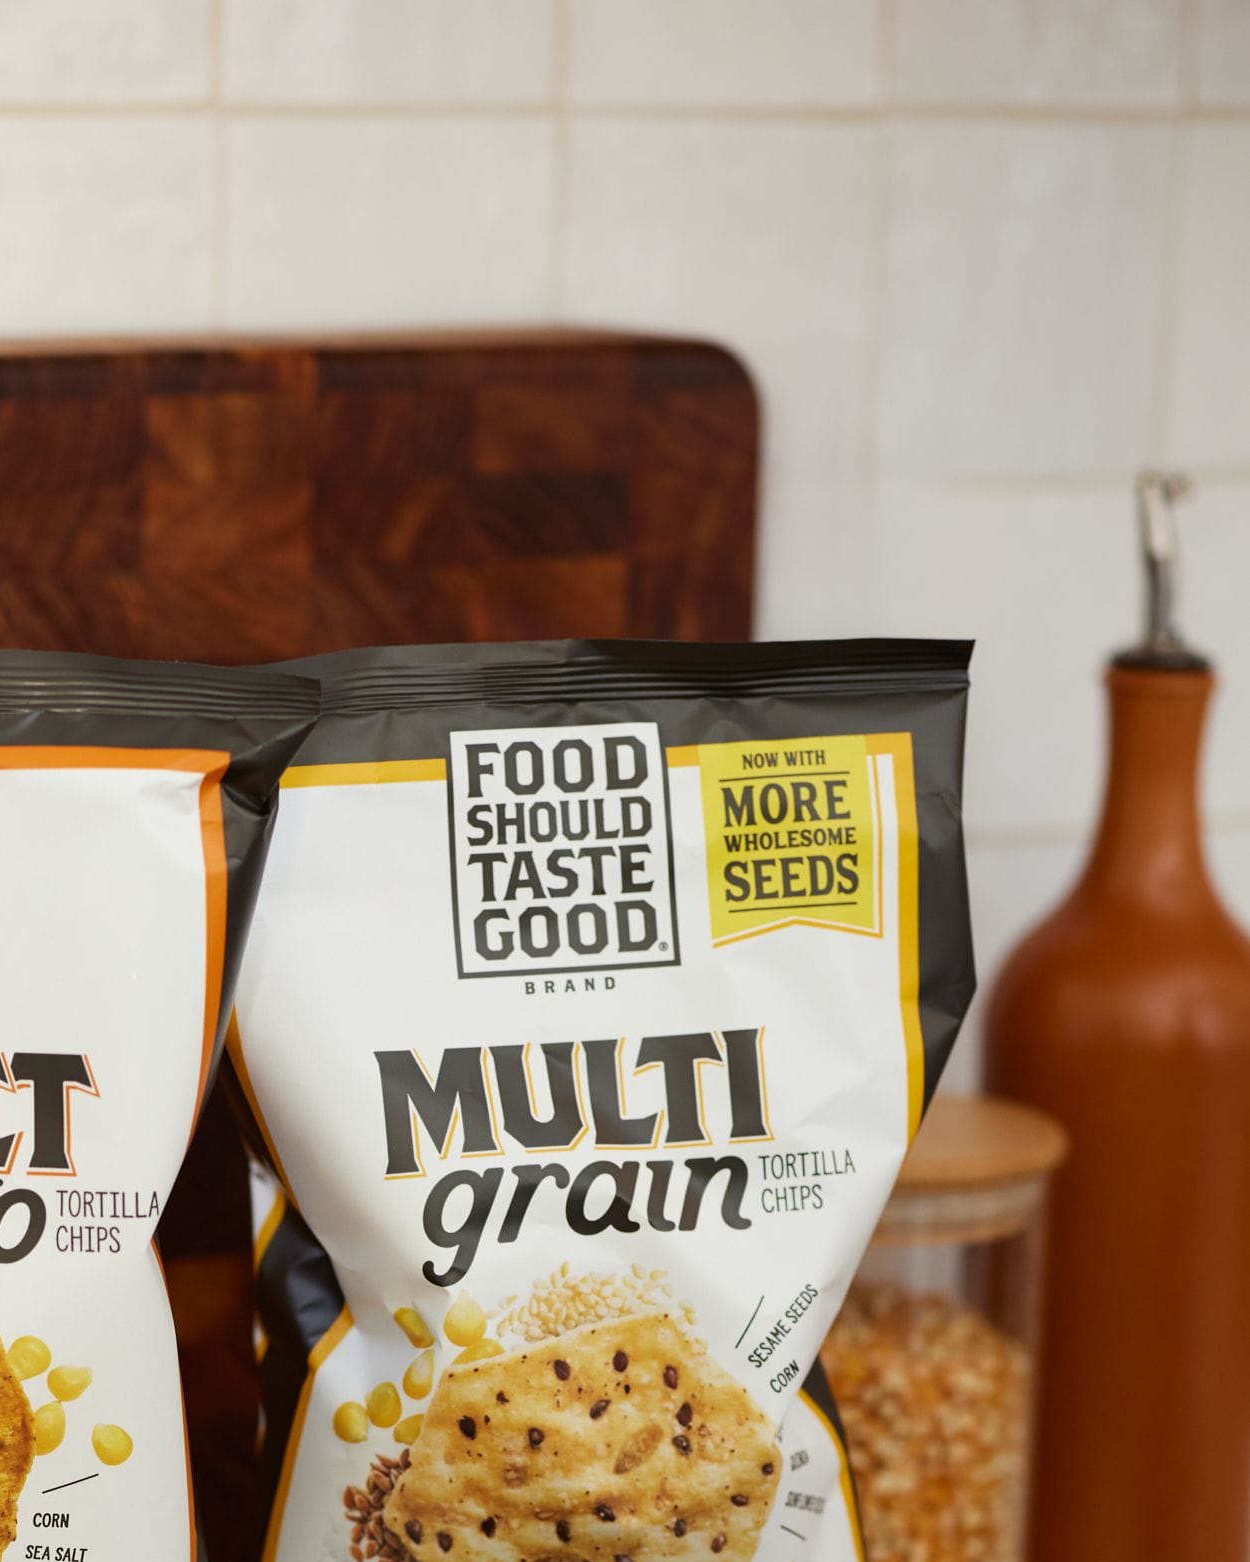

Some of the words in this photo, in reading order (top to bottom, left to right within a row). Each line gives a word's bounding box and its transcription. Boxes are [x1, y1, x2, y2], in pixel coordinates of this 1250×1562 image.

[464, 735, 648, 799] FOOD
[741, 751, 779, 771] NOW
[786, 749, 826, 767] WITH
[722, 780, 852, 828] MORE
[466, 795, 653, 848] SHOULD
[724, 828, 857, 852] WHOLESOME
[467, 844, 655, 902] TASTE
[724, 854, 860, 902] SEEDS
[525, 976, 617, 996] BRAND
[374, 1026, 774, 1180] MULTI
[757, 1149, 856, 1181] TORTILLA
[54, 1189, 161, 1219] TORTILLA
[760, 1183, 824, 1214] CHIPS
[420, 1154, 753, 1288] grain
[55, 1224, 121, 1254] CHIPS
[748, 1319, 792, 1369] SESAME
[785, 1283, 818, 1324] SEEDS
[770, 1360, 800, 1393] CORN
[32, 1512, 70, 1529] CORN
[24, 1544, 51, 1561] SEA
[54, 1546, 89, 1562] SALT
